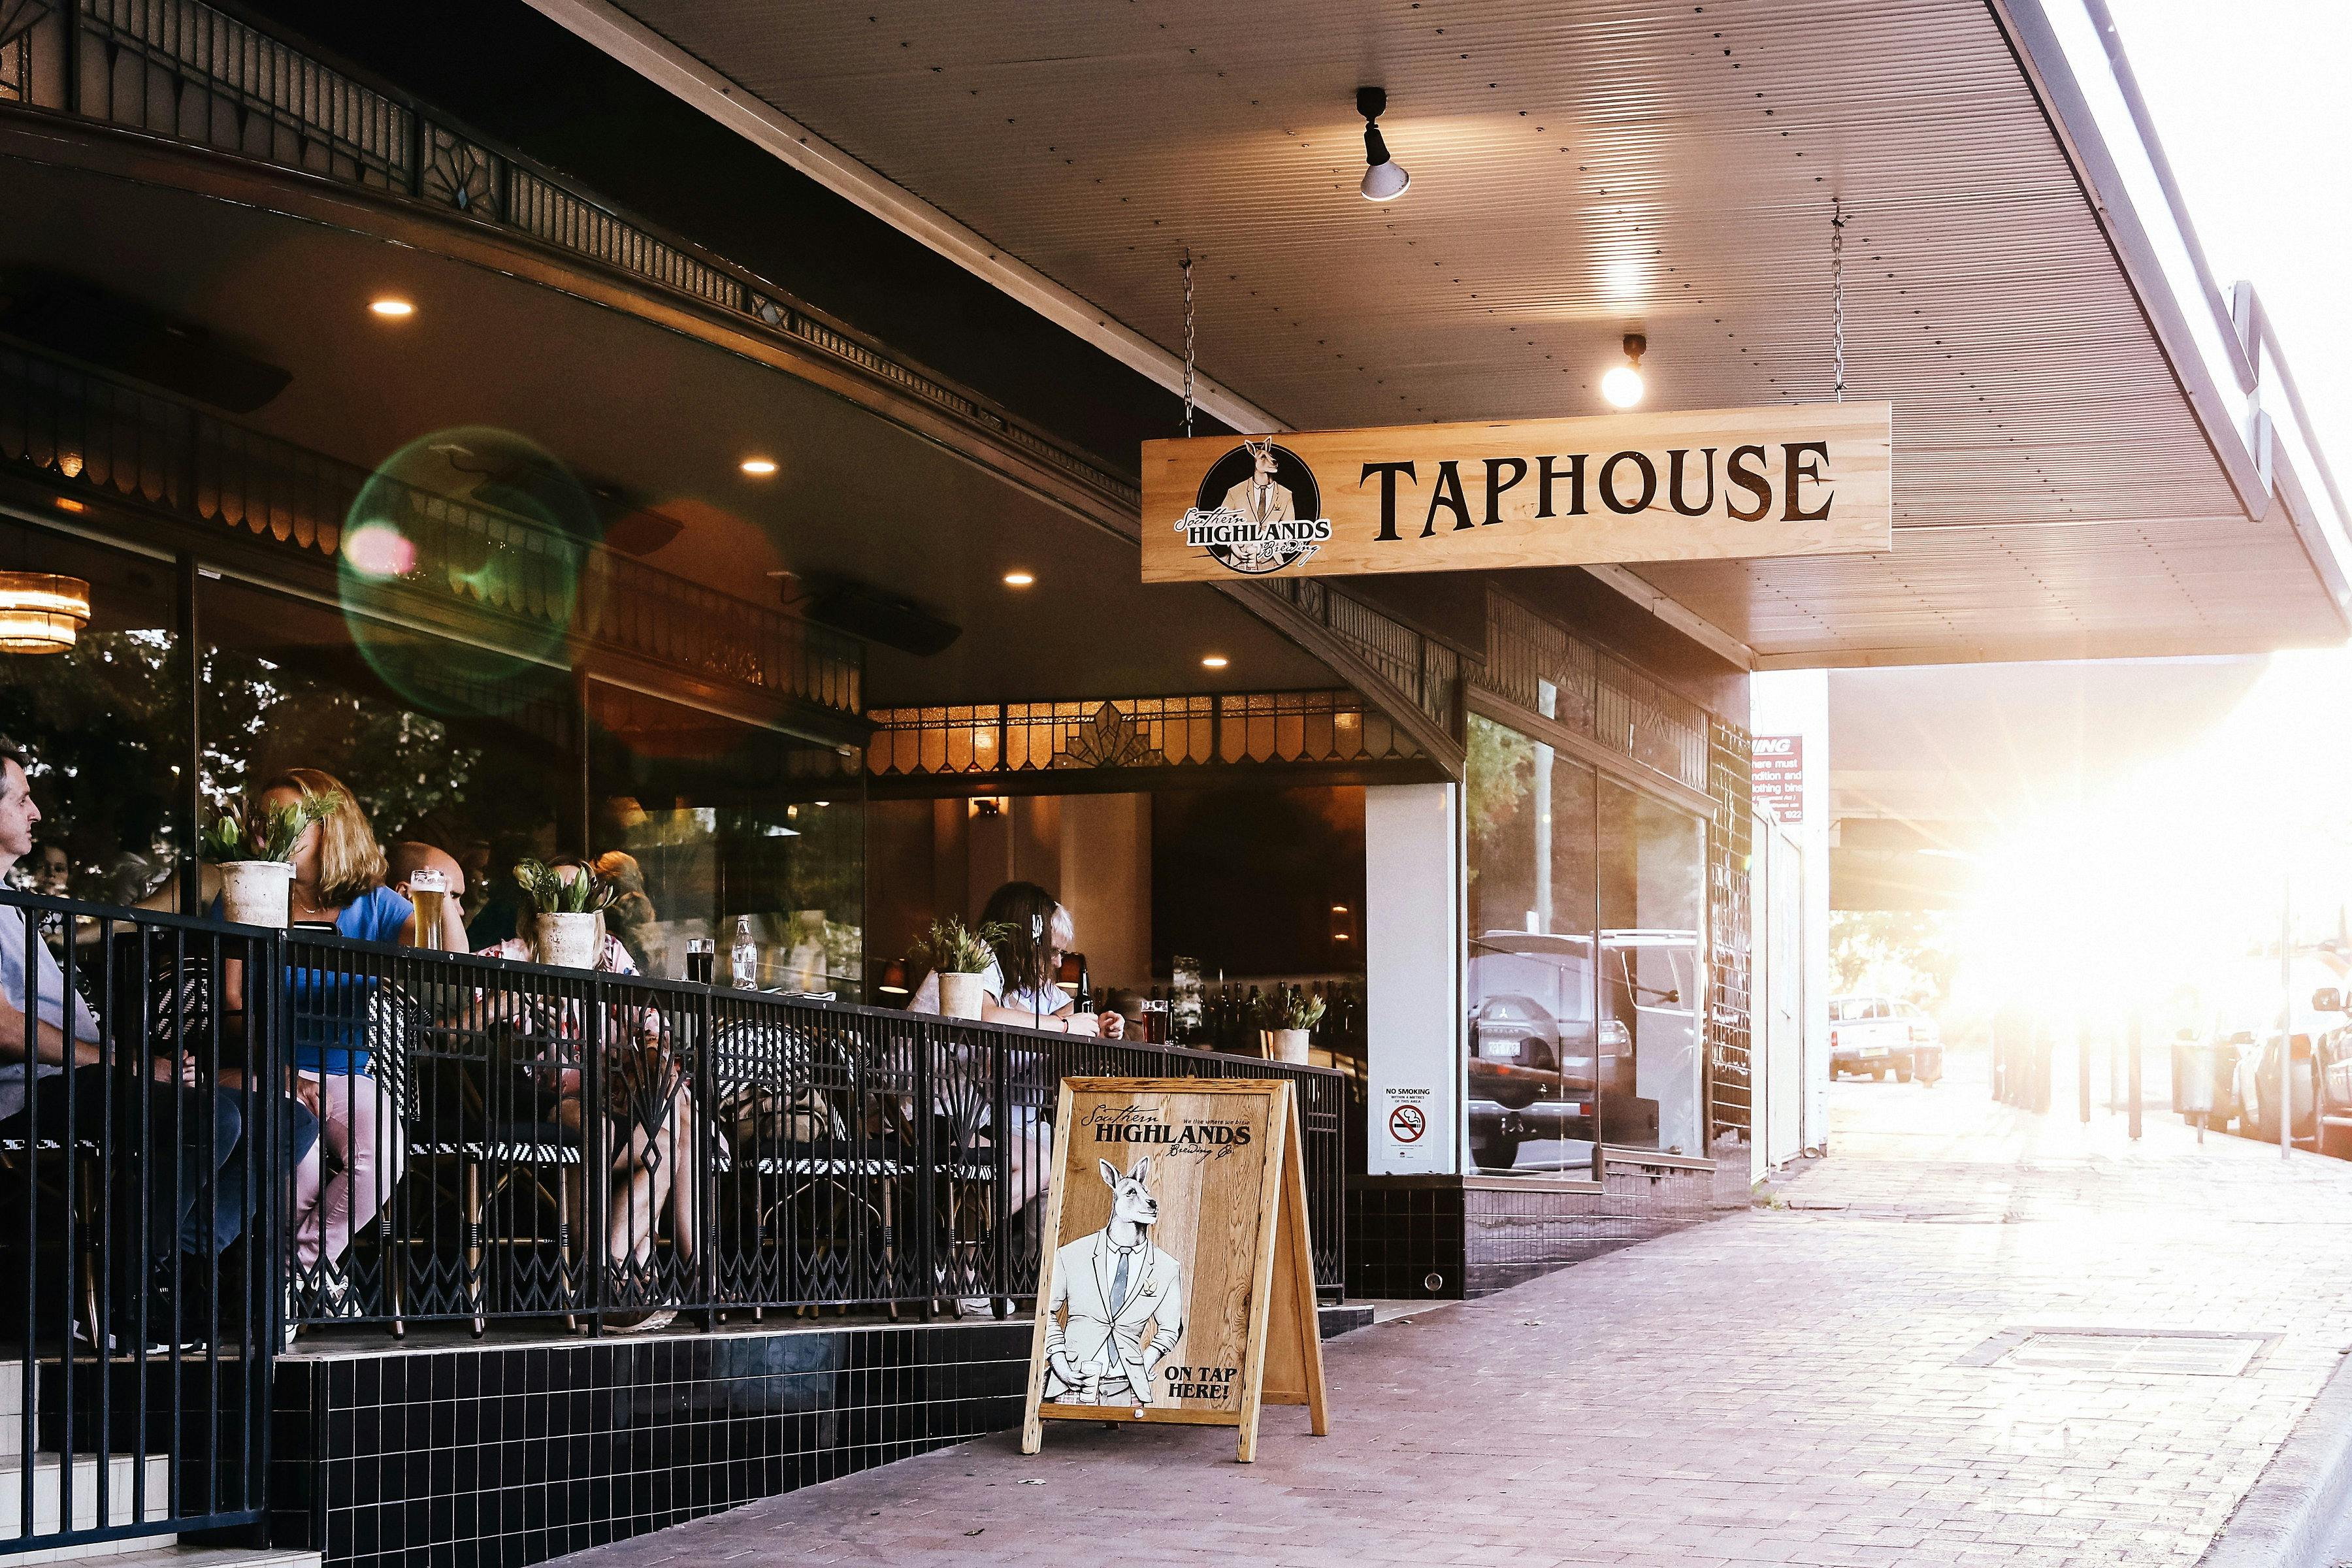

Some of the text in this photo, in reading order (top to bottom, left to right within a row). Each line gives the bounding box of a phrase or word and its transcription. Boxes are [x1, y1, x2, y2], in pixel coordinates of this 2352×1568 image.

[1360, 440, 1834, 541] TAPHOUSE
[1175, 508, 1245, 531] Southern
[1189, 521, 1330, 544] HIGHLANDS
[1258, 541, 1320, 566] Brewing
[1775, 759, 1797, 768] must
[1785, 771, 1801, 779] and
[1785, 783, 1803, 792] bins
[1081, 1104, 1159, 1126] Southern
[1094, 1124, 1251, 1145] HIGHLANDS
[1166, 1144, 1213, 1164] Brewing
[1165, 1366, 1237, 1382] ON TAP
[1168, 1383, 1229, 1399] HERE!
